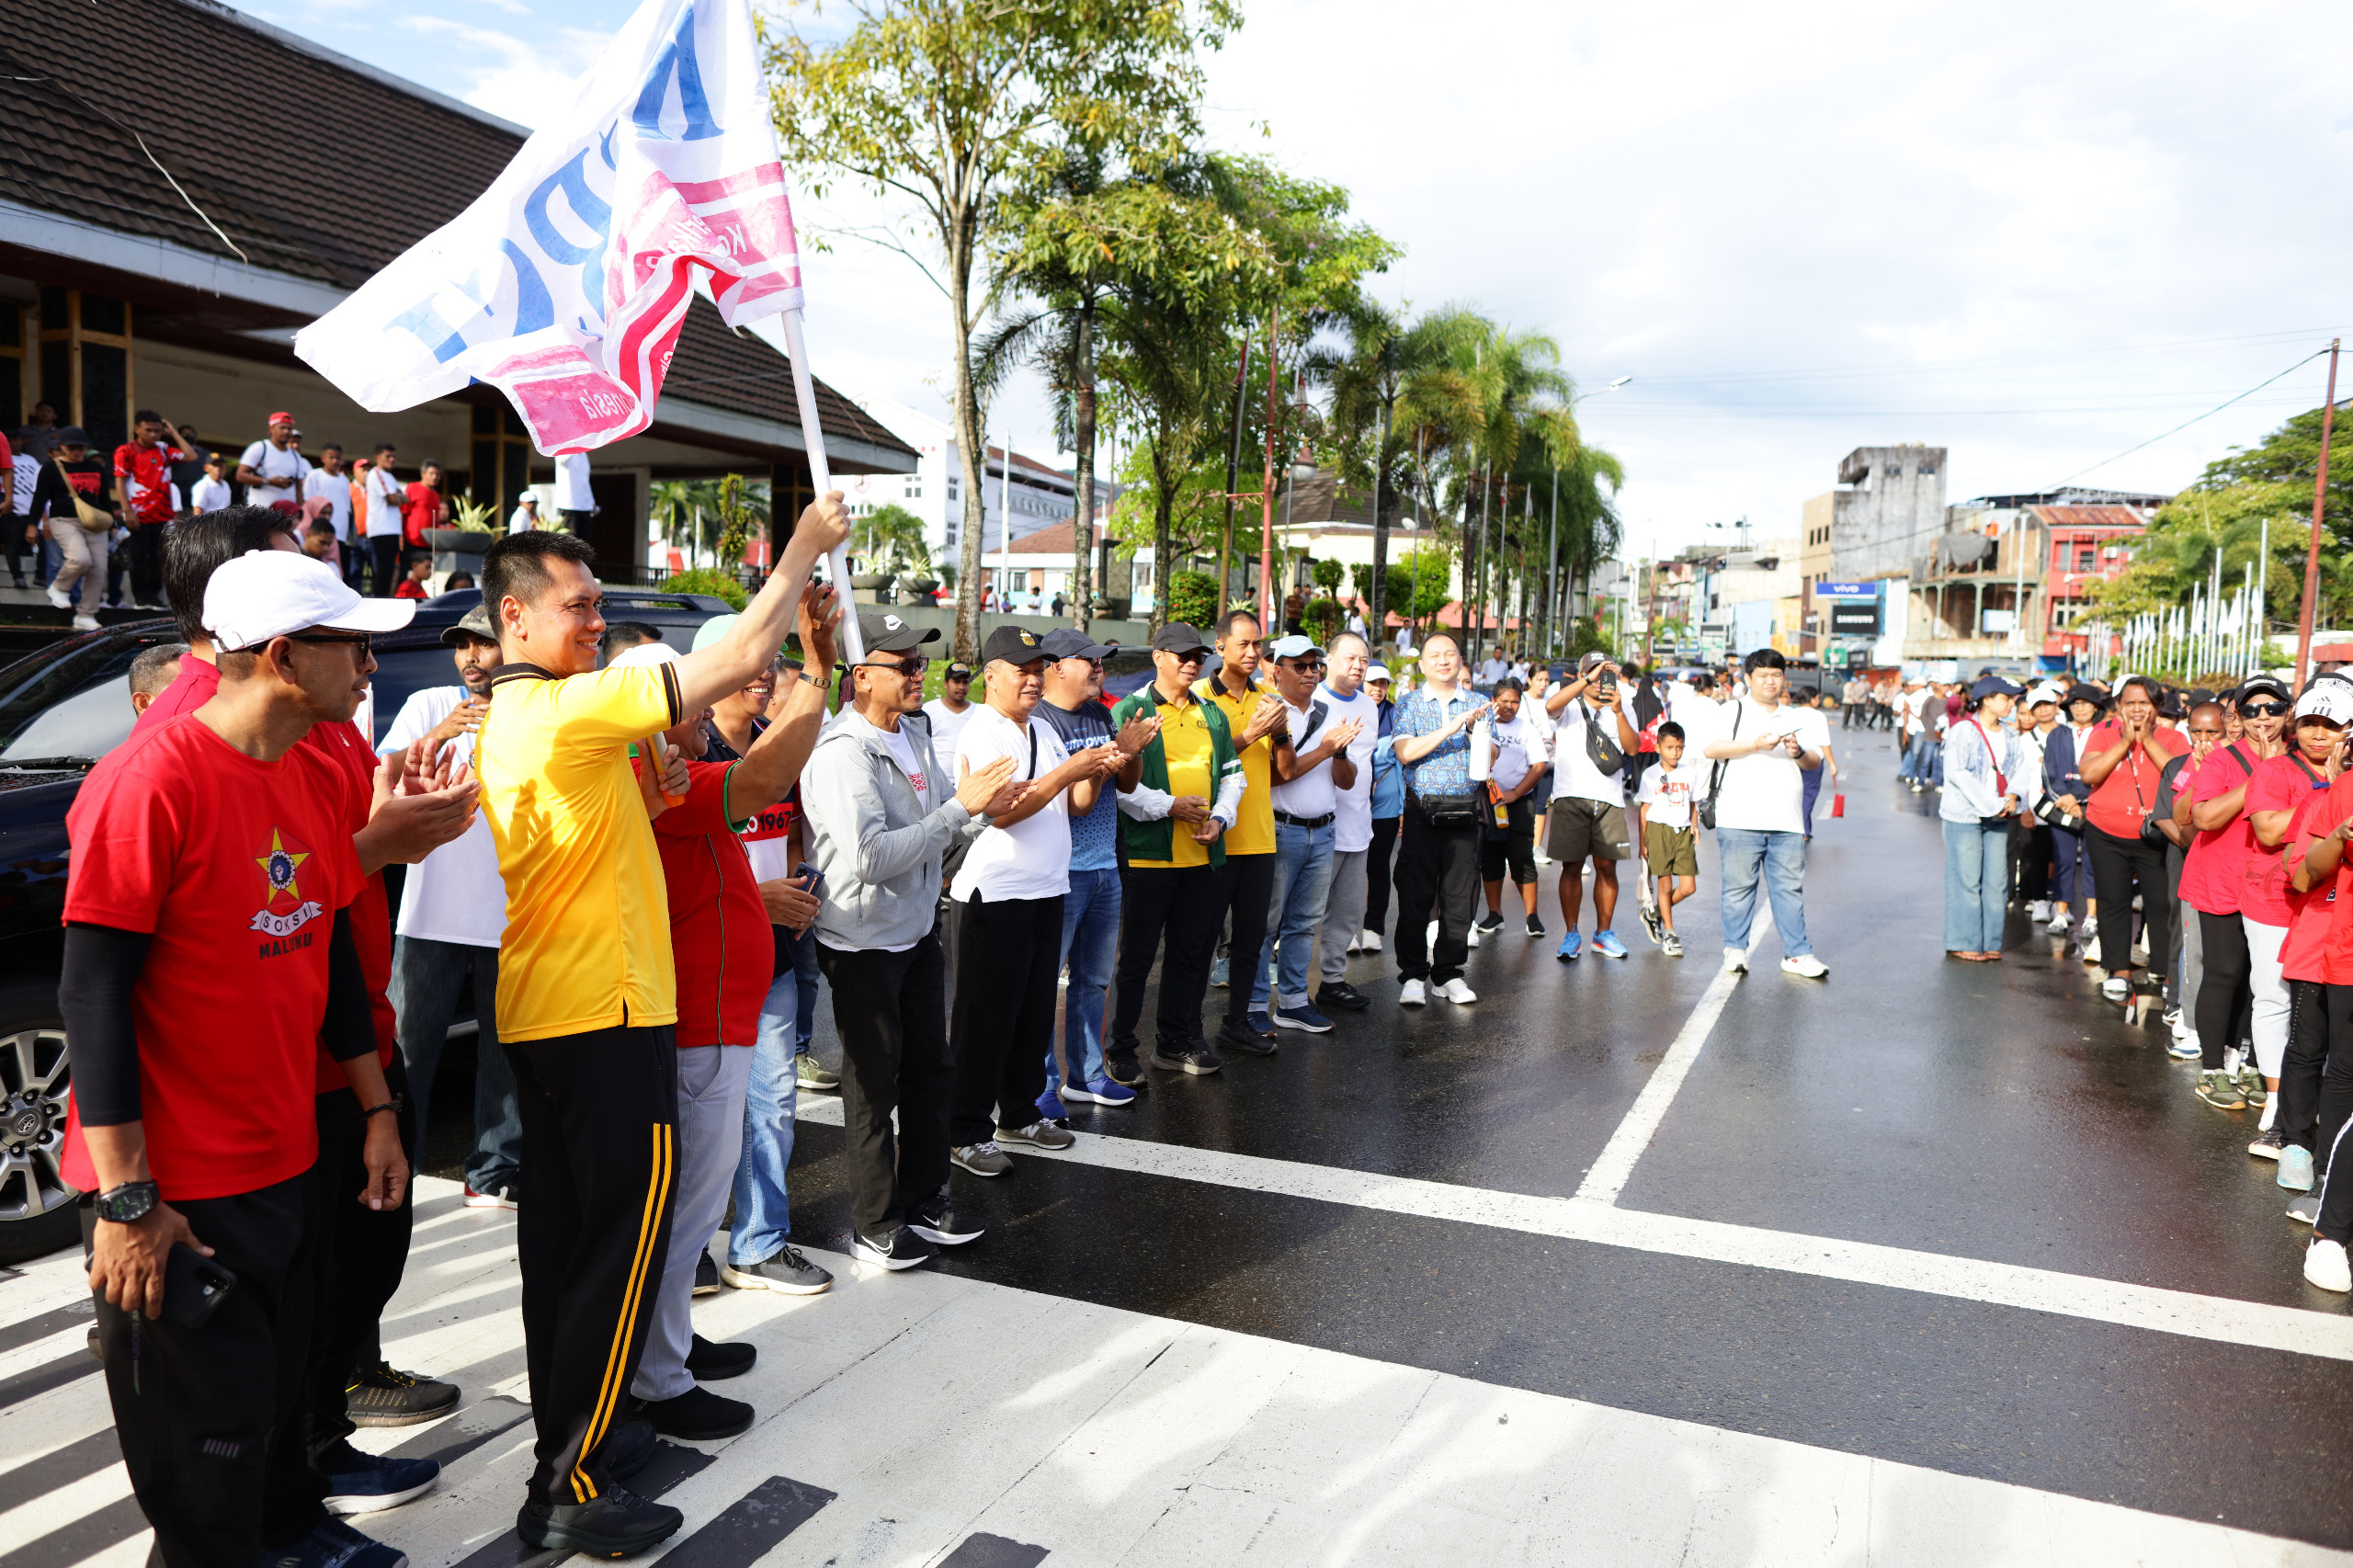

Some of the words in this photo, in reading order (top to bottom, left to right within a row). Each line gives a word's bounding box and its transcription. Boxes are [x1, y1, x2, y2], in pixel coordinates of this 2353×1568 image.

[1833, 584, 1859, 593] vivo
[758, 810, 792, 832] 1967
[263, 908, 309, 933] SOKSI
[259, 932, 313, 960] MALUKU
[131, 1323, 140, 1358] UNDER
[529, 1501, 560, 1518] HOKA
